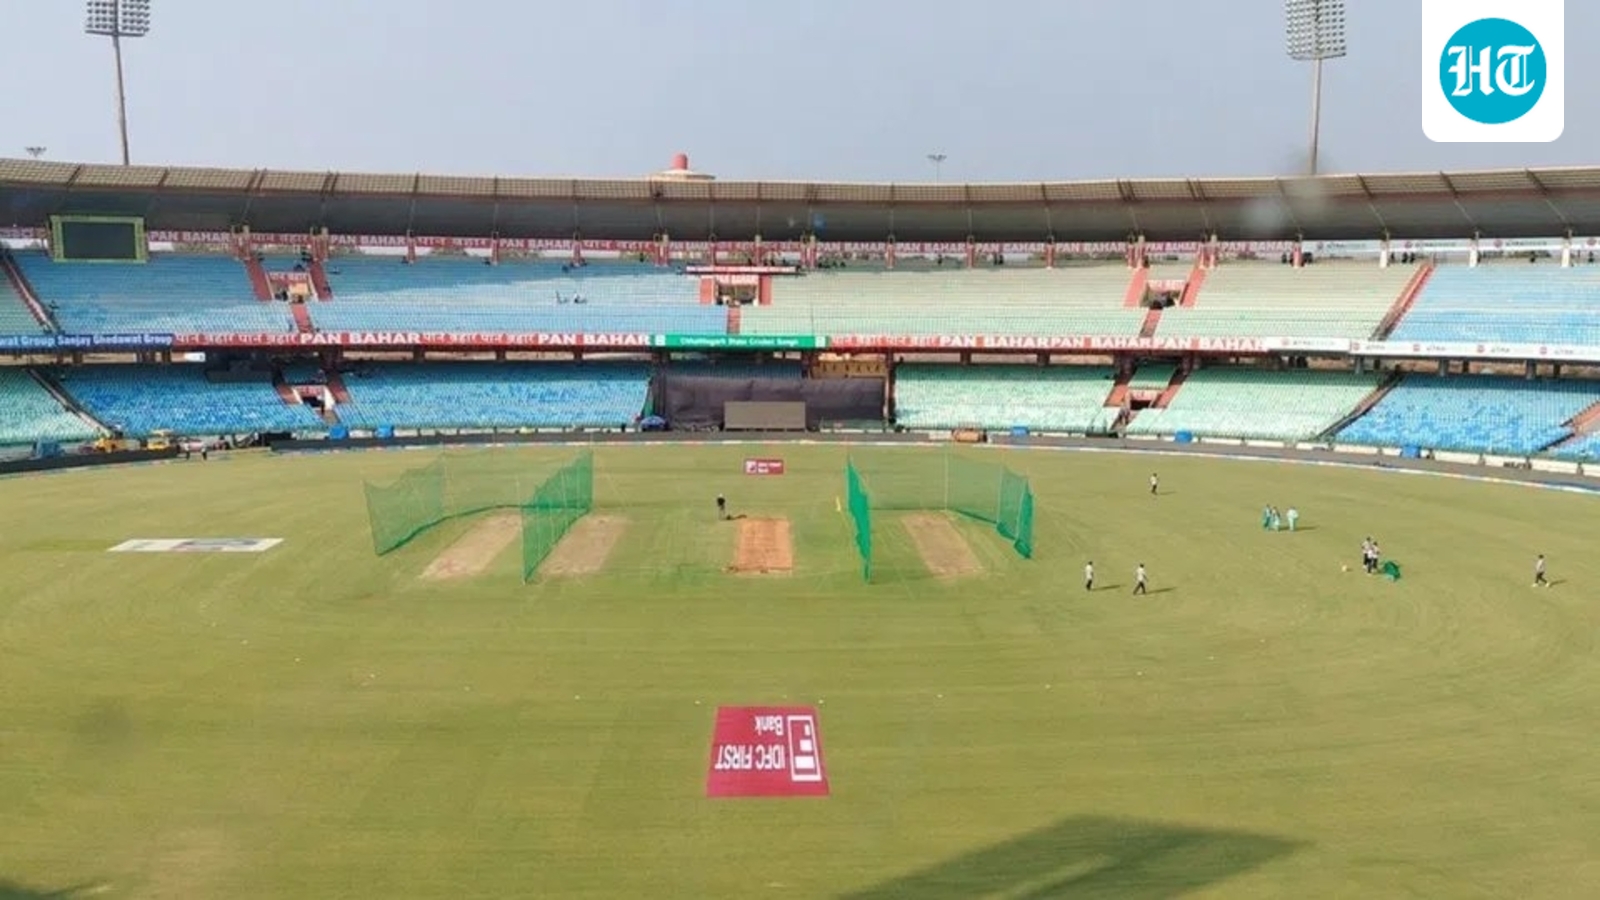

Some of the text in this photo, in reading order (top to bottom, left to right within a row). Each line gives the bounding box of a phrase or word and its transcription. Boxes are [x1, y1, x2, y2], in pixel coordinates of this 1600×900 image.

[21, 336, 55, 347] Group
[58, 336, 91, 347] Sanjay
[143, 334, 173, 346] Group
[299, 333, 421, 345] PAN BAHAR
[538, 334, 651, 345] PAN BAHAR
[940, 336, 976, 347] PAN
[754, 715, 784, 736] Bank
[714, 744, 786, 770] IDFC FIRST
